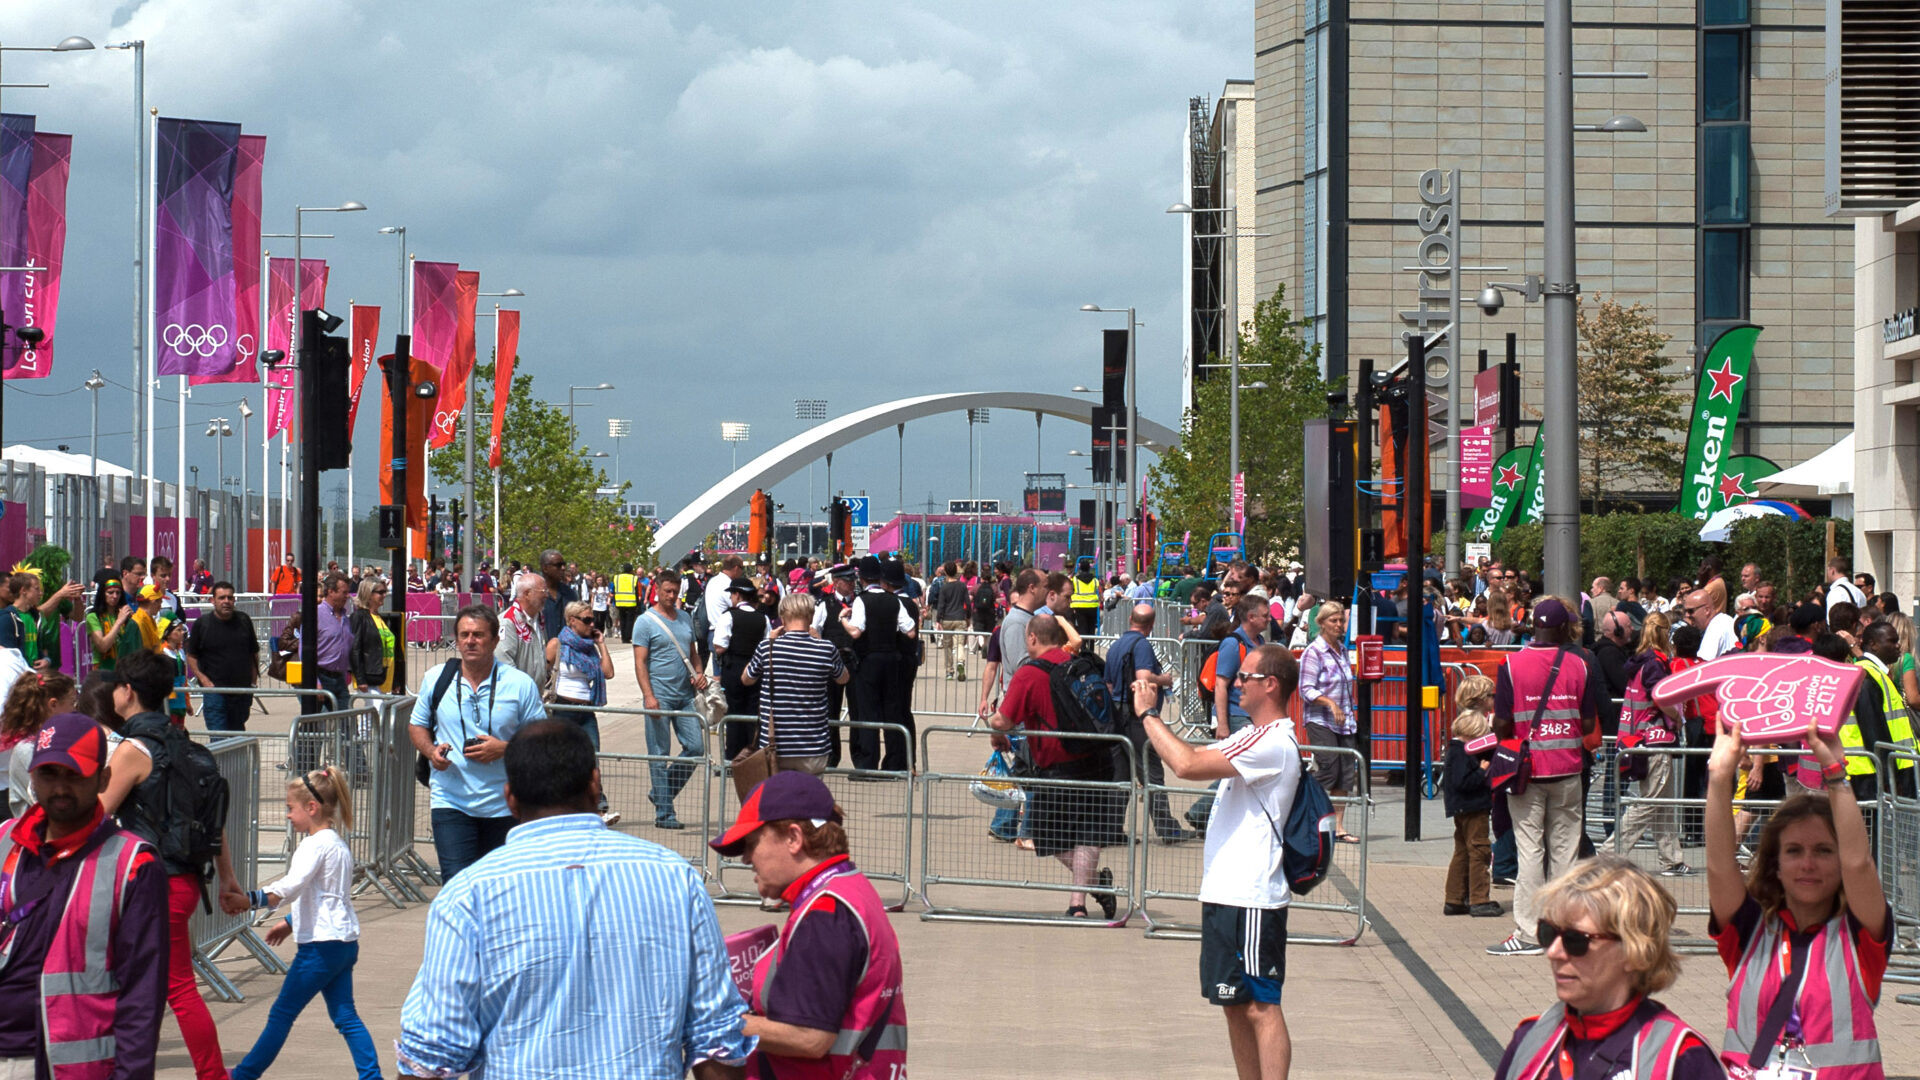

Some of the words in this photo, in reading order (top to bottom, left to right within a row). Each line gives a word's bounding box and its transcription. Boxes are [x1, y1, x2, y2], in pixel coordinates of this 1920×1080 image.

[1801, 675, 1821, 716] London
[1814, 675, 1841, 716] 2012
[1540, 722, 1571, 737] 3482
[1219, 985, 1236, 995] Brit
